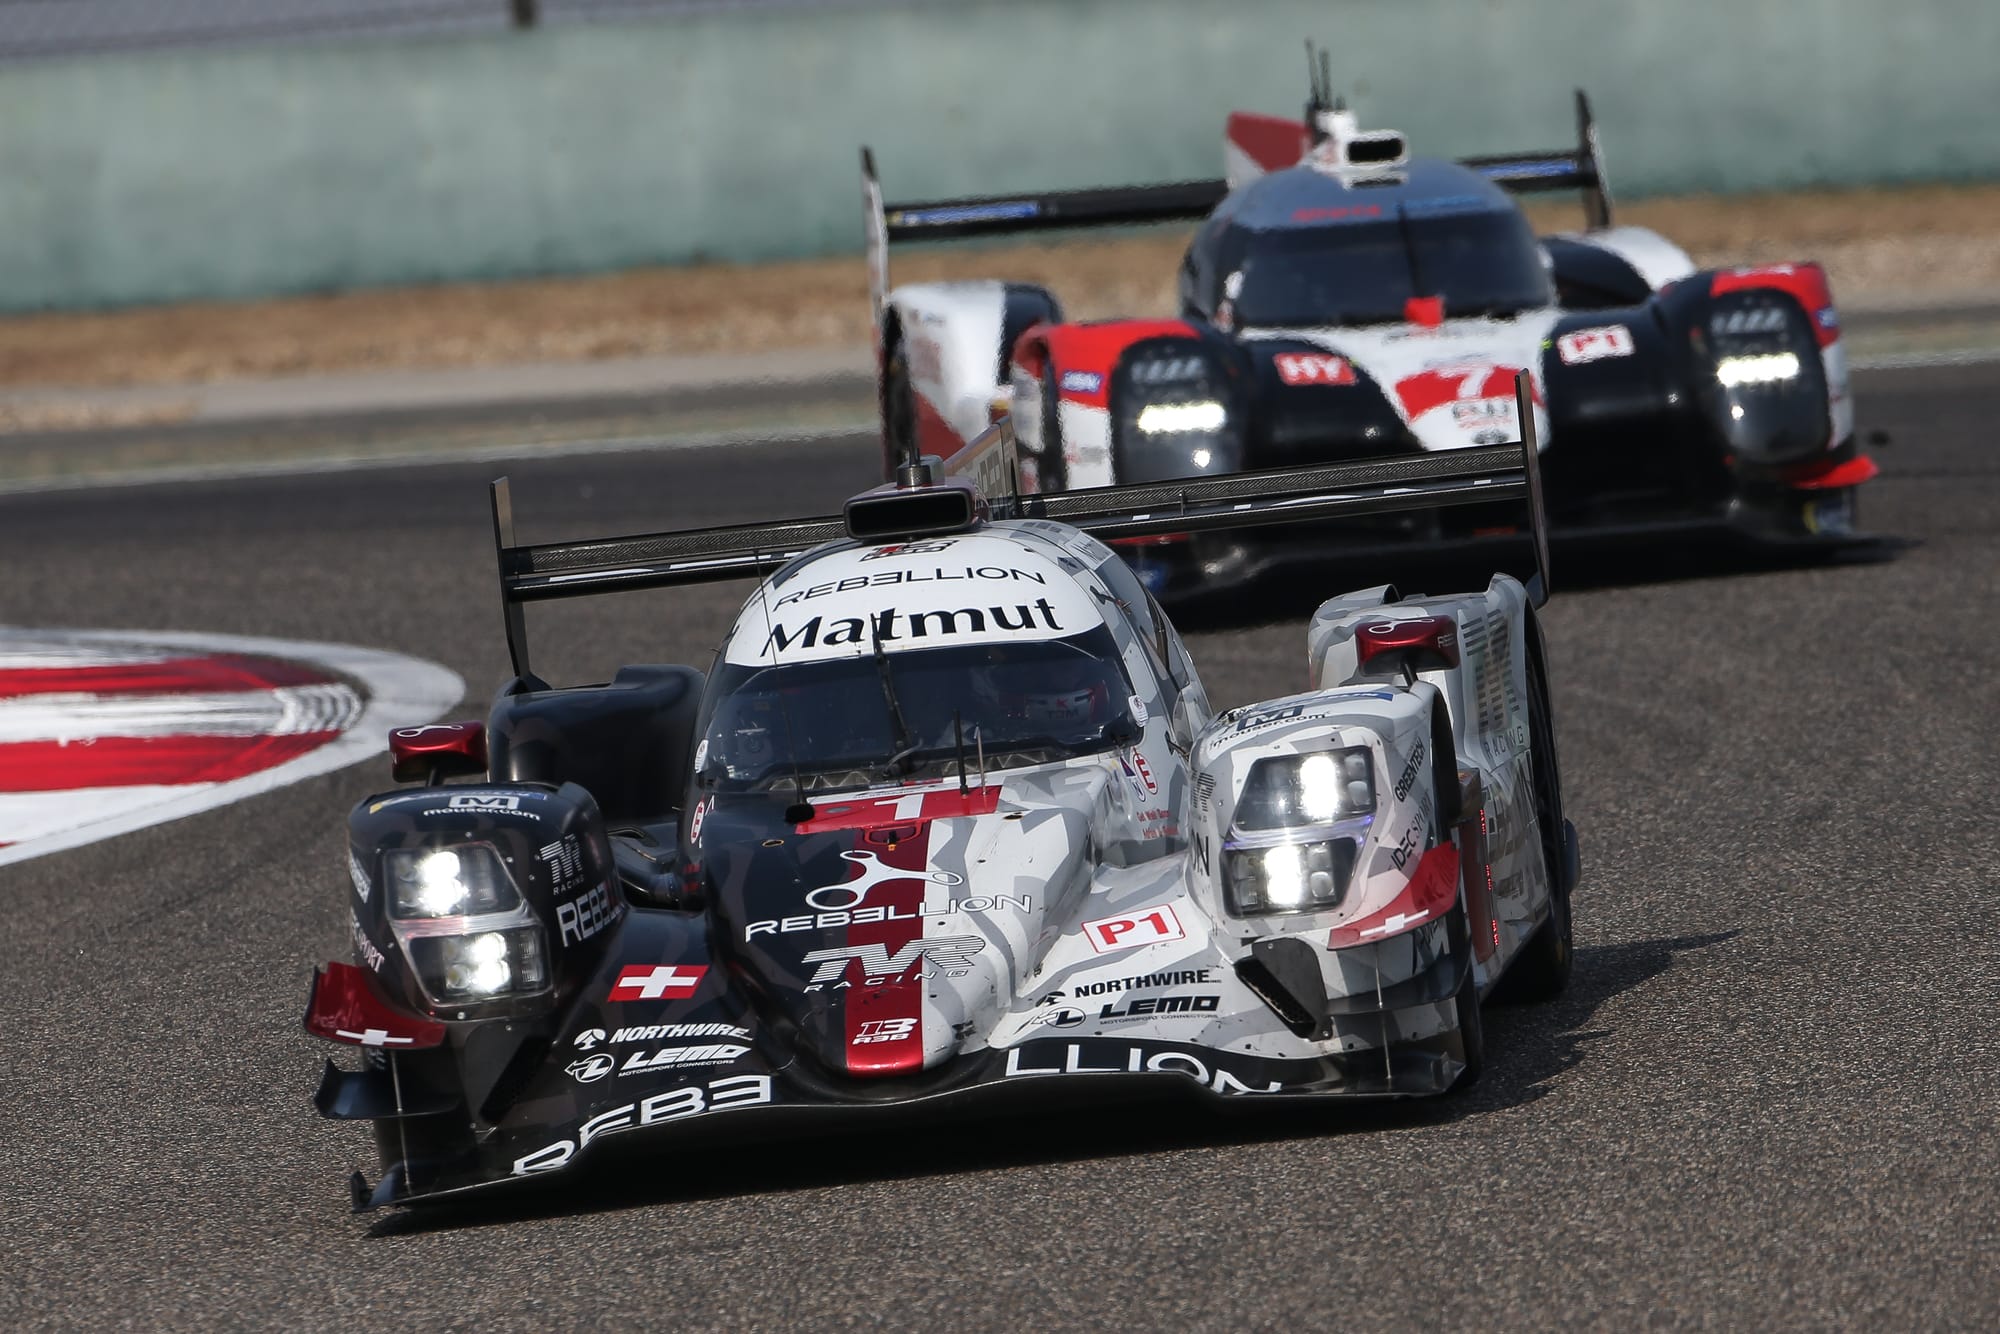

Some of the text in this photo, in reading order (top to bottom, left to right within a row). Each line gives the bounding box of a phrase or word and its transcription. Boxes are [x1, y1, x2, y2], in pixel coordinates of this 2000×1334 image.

[1574, 334, 1618, 353] P1
[1283, 359, 1345, 381] HY
[1434, 361, 1495, 400] 7
[772, 566, 1047, 613] REBELLION
[759, 597, 1065, 658] Matmut
[1213, 713, 1327, 747] mouser.com
[1394, 738, 1426, 803] GREENTECH
[423, 807, 541, 822] mouser.com
[874, 793, 924, 821] 1
[744, 894, 1032, 944] REBELLION
[1096, 911, 1169, 945] P1
[801, 934, 987, 983] TVR
[803, 968, 969, 994] RACING
[1074, 969, 1210, 998] NORTHWIRE
[1099, 995, 1221, 1019] LEMO
[1100, 1014, 1158, 1025] MOTORSPORT
[608, 1022, 752, 1045] NORTHWIRE
[617, 1059, 735, 1078] MOTORSPORT CONNECTORS
[620, 1044, 751, 1071] LEMO
